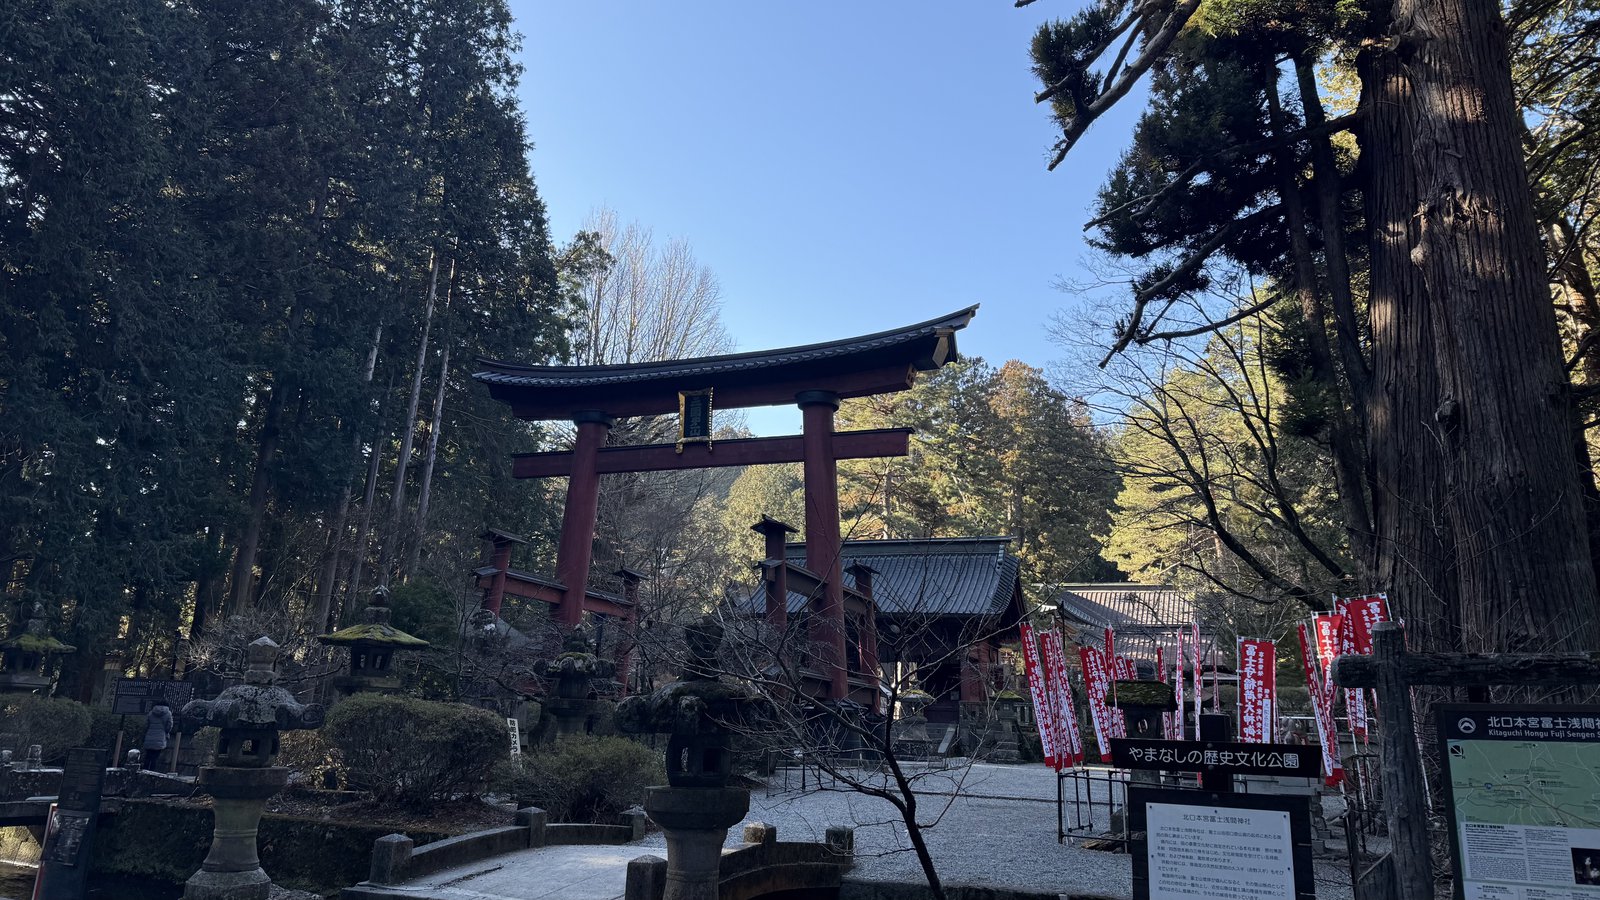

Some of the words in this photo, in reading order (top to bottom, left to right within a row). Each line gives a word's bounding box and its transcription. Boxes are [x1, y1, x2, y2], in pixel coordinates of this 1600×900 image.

[1488, 729, 1522, 738] Kitaguchi
[1524, 730, 1549, 738] Hongu
[1550, 730, 1565, 739] Fuji
[1566, 731, 1595, 739] Sengen
[1128, 746, 1300, 769] やまなしの歴史文化公園
